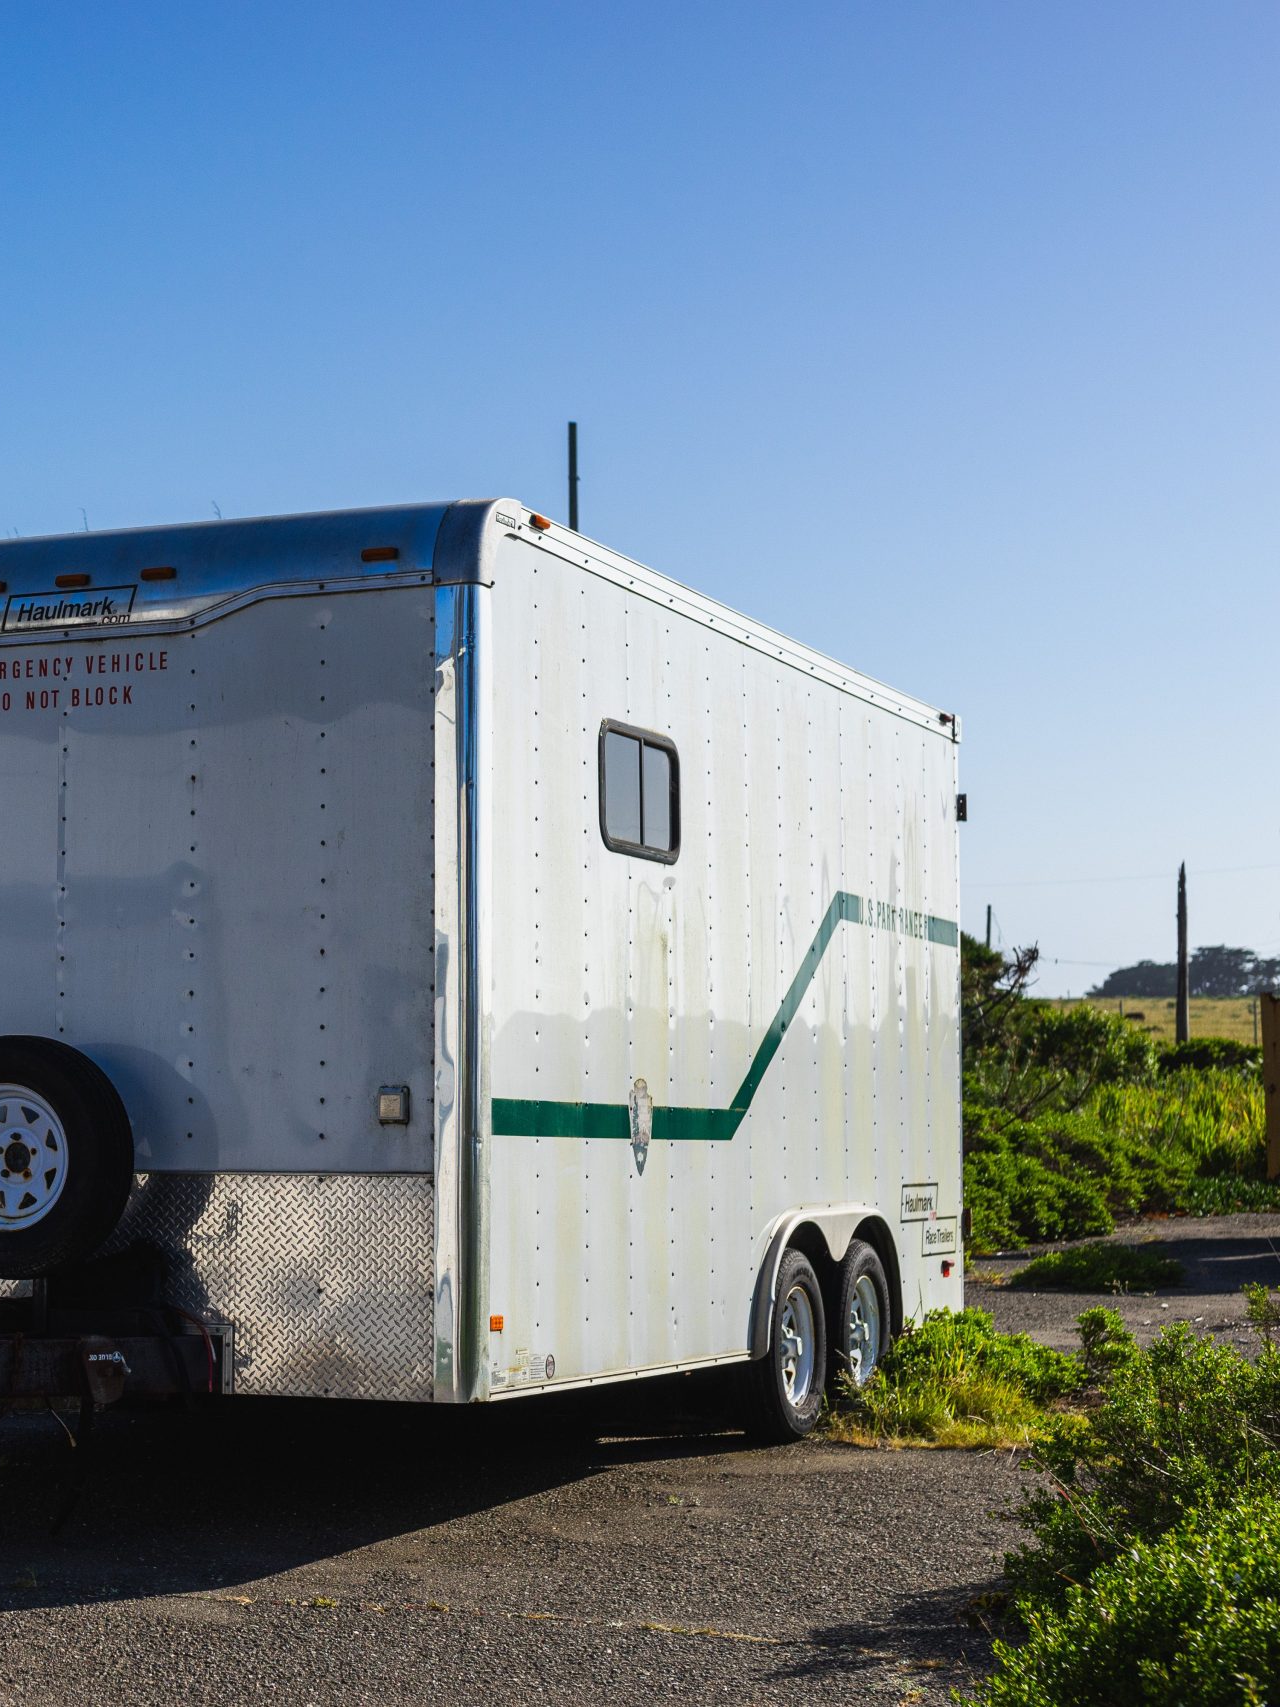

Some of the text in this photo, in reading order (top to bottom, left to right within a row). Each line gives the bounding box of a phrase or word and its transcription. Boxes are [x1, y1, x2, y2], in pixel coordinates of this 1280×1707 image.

[17, 596, 116, 623] Haulmark
[86, 651, 168, 674] VEHICLE
[26, 689, 61, 710] NOT
[71, 685, 133, 707] BLOCK
[899, 907, 928, 941] RANGER
[904, 1193, 934, 1213] Haulmark
[926, 1229, 953, 1244] Race Trailers
